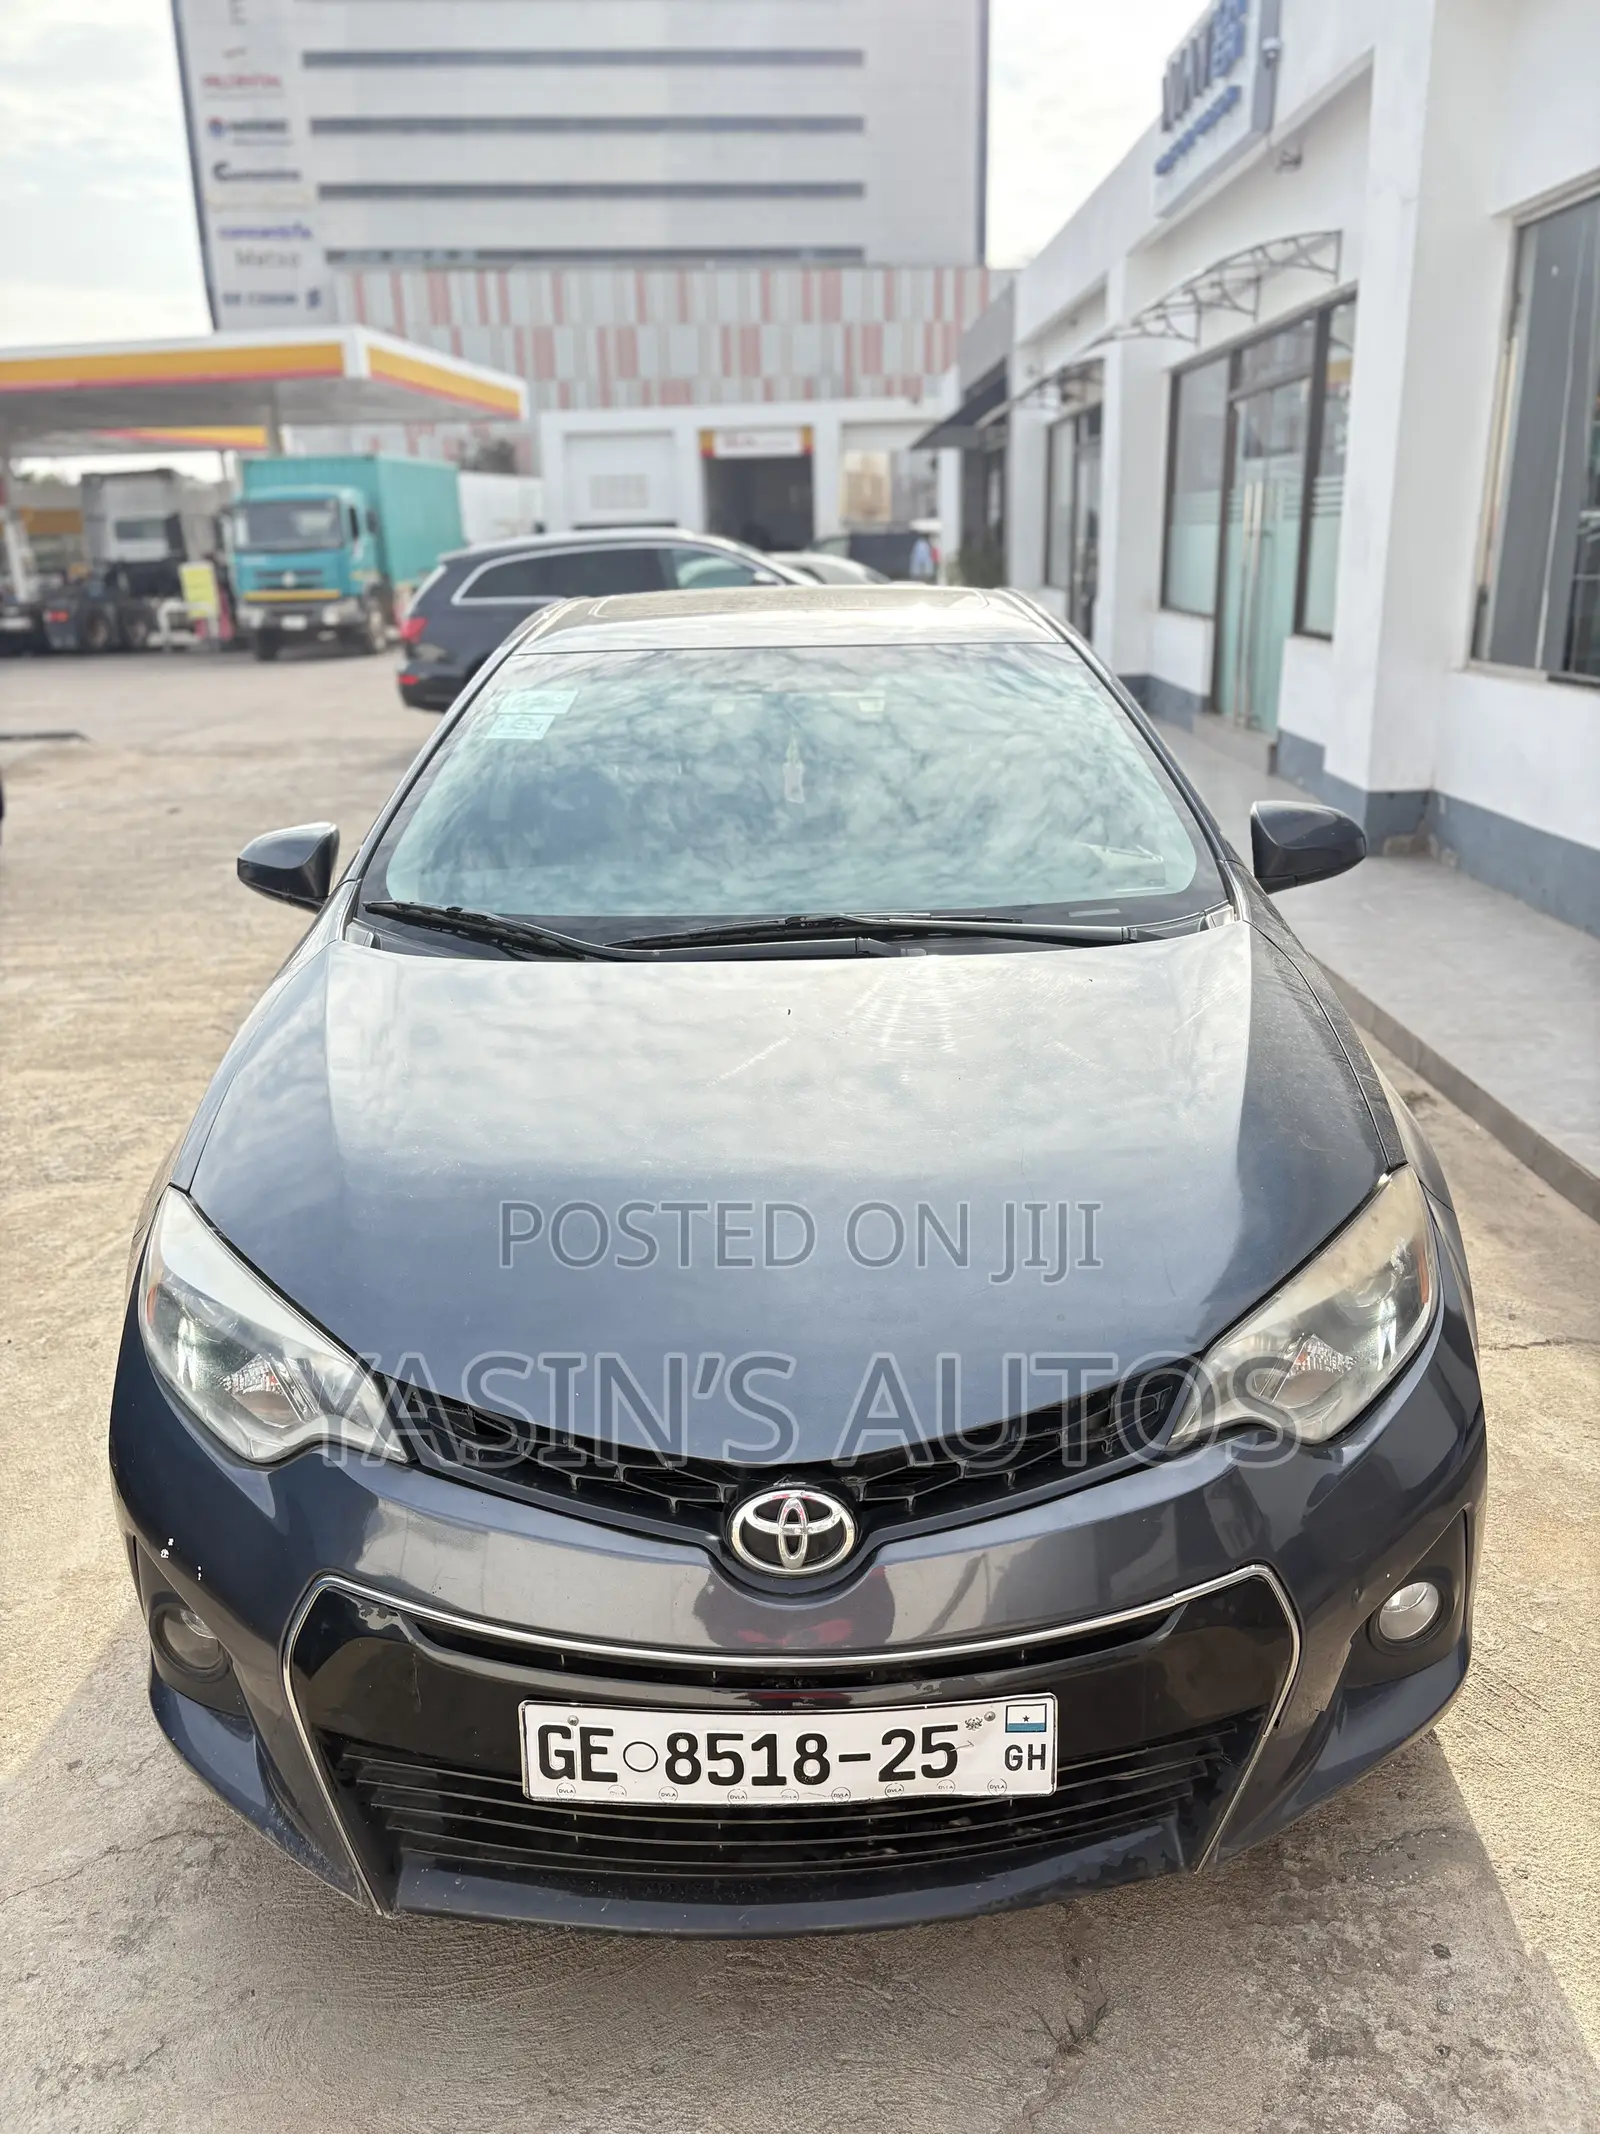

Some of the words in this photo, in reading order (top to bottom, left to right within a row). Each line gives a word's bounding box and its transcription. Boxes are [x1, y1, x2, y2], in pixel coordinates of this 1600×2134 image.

[537, 1724, 619, 1783] GE
[665, 1724, 959, 1786] 8518-25
[1004, 1743, 1046, 1771] GH
